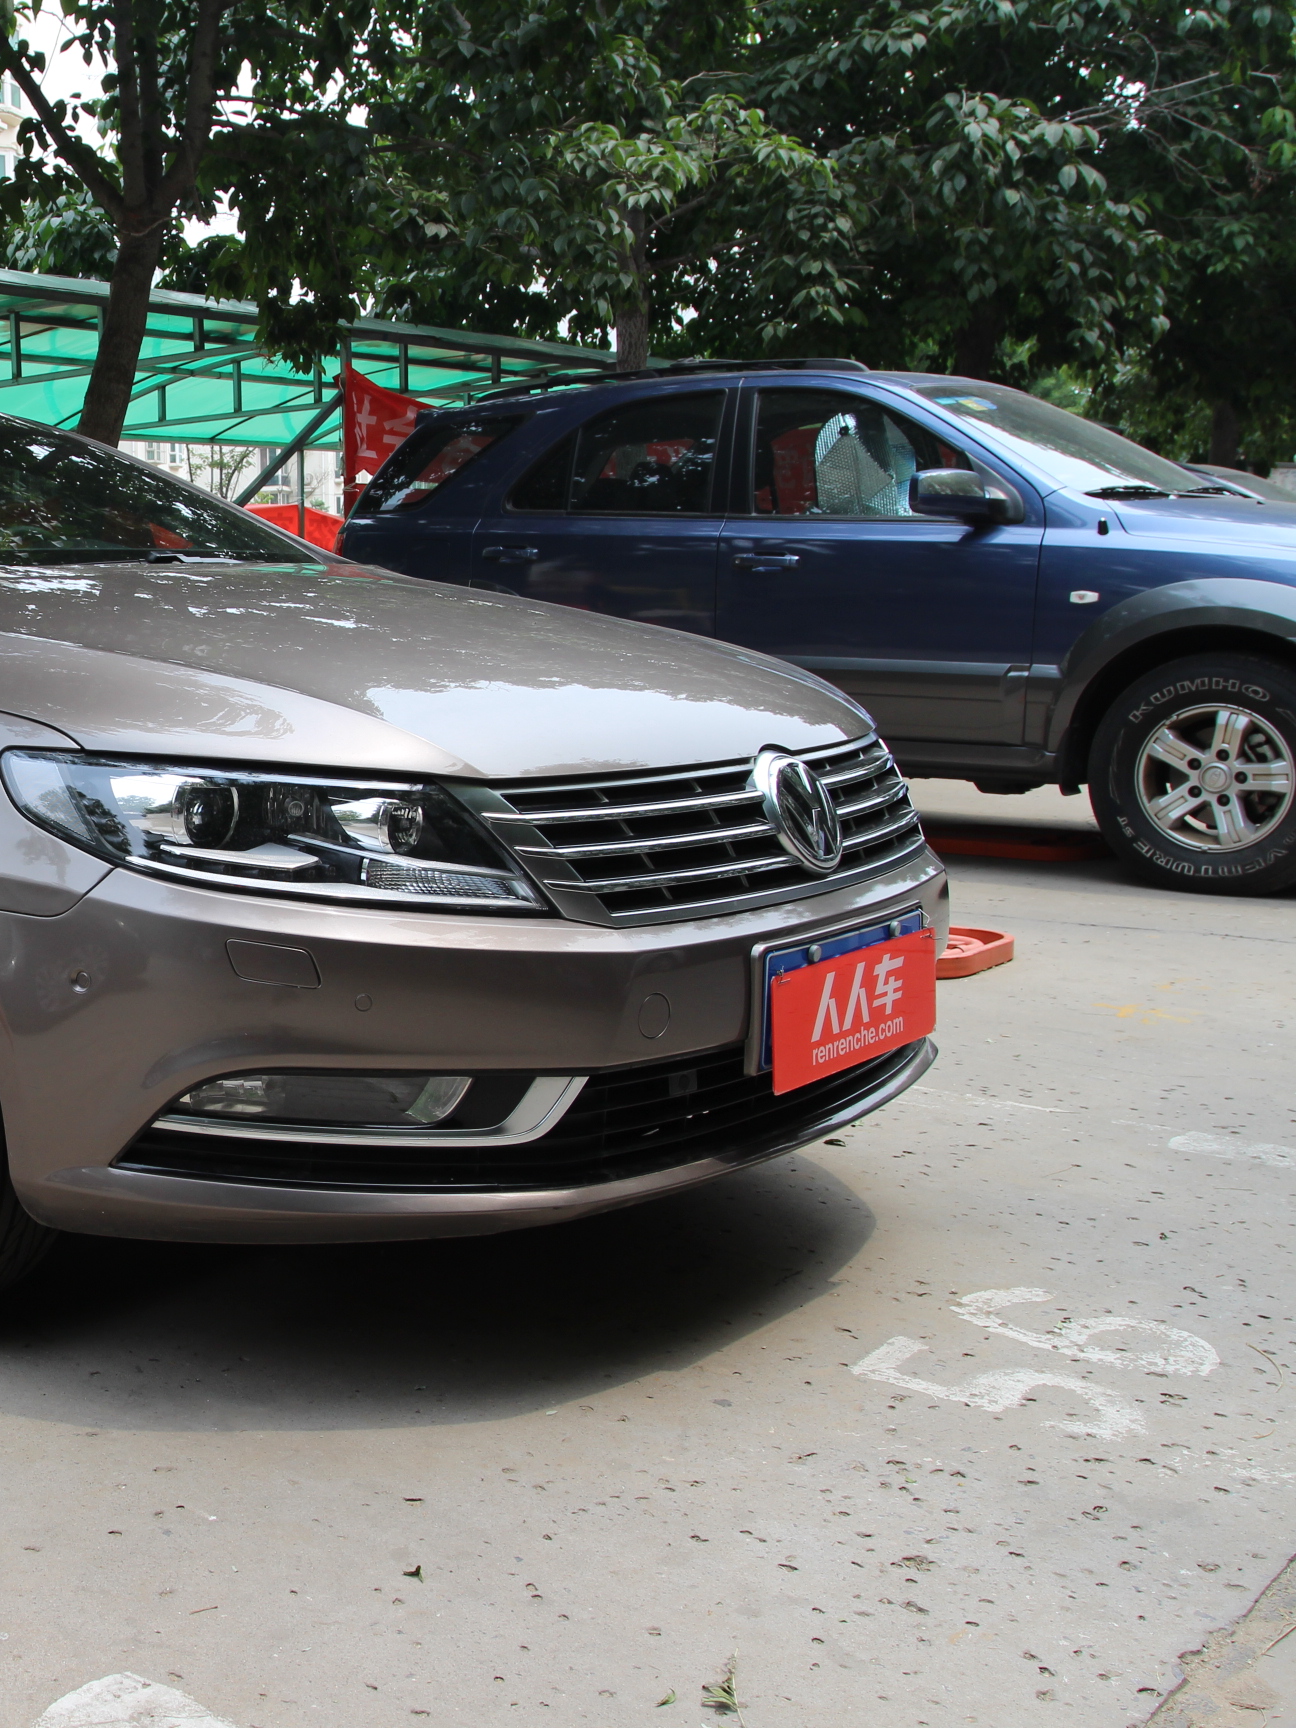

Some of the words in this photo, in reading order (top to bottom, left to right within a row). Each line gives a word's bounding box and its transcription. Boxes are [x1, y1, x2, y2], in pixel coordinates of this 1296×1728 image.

[1128, 677, 1270, 723] KUMHO
[811, 953, 904, 1043] 人人车
[812, 1016, 904, 1065] renrenche.com
